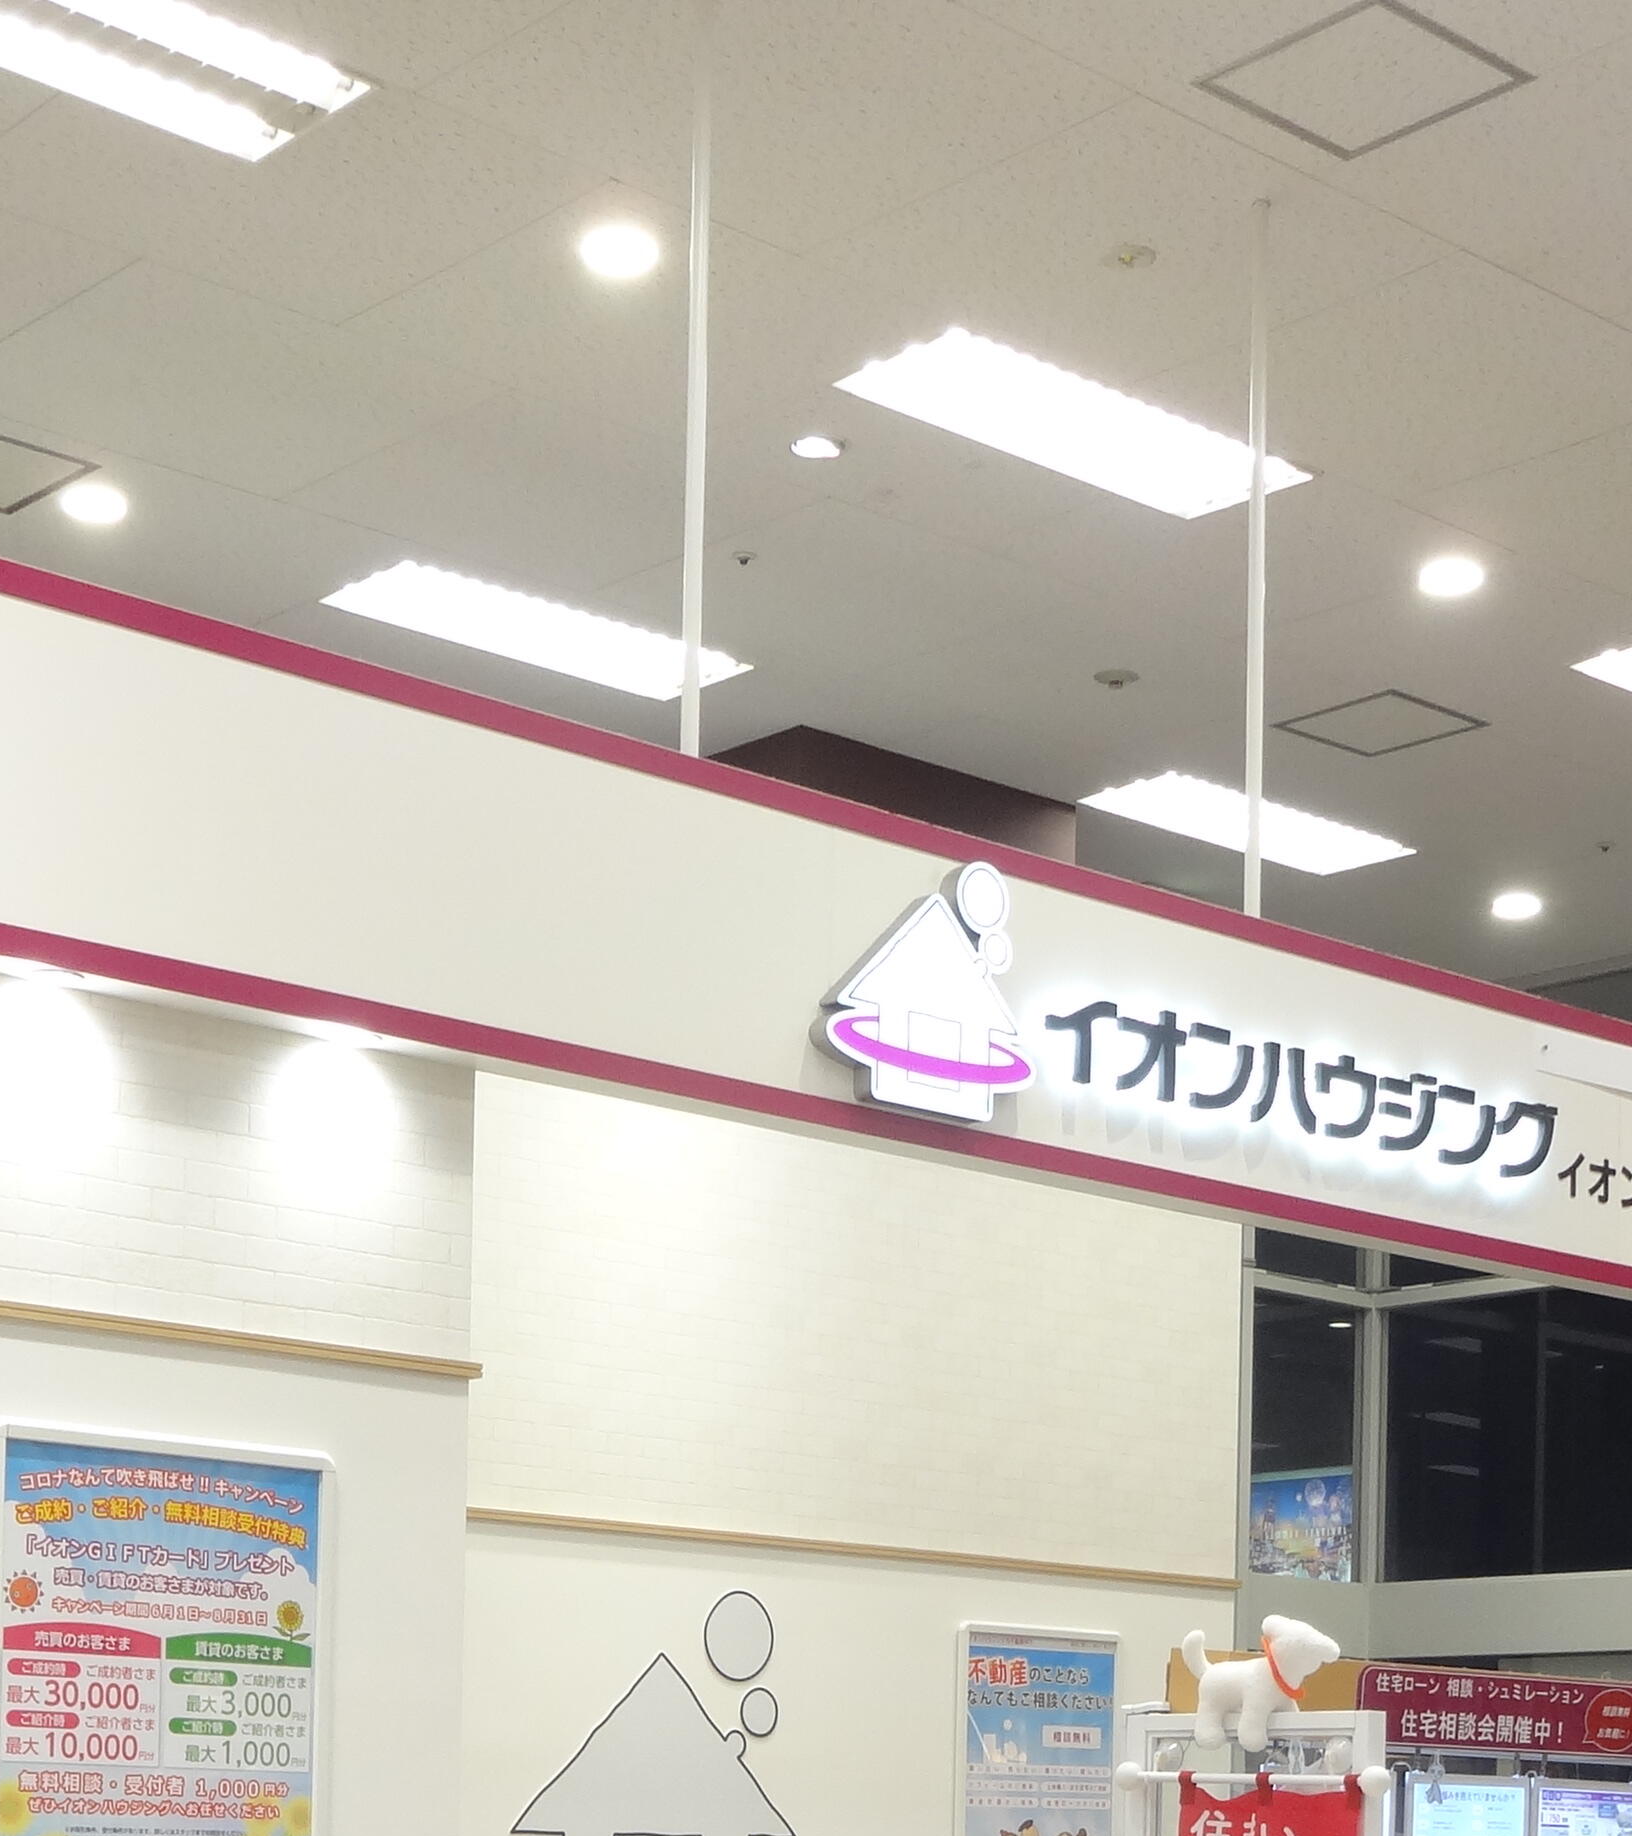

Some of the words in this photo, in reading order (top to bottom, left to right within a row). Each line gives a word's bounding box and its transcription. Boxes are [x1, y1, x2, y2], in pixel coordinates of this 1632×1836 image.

[1045, 1000, 1557, 1176] イオンハウジング
[34, 1631, 131, 1651] 売買のお客さま
[195, 1642, 283, 1660] 賃貸のお客さま
[86, 1665, 156, 1681] ご成約者さま
[968, 1657, 1089, 1685] 不動産のことなら
[1376, 1672, 1440, 1694] 住宅ローン
[85, 1716, 155, 1731] ご紹介者さま
[1400, 1709, 1563, 1746] 住宅相談会開催中！
[1053, 1732, 1091, 1743] 相談無料
